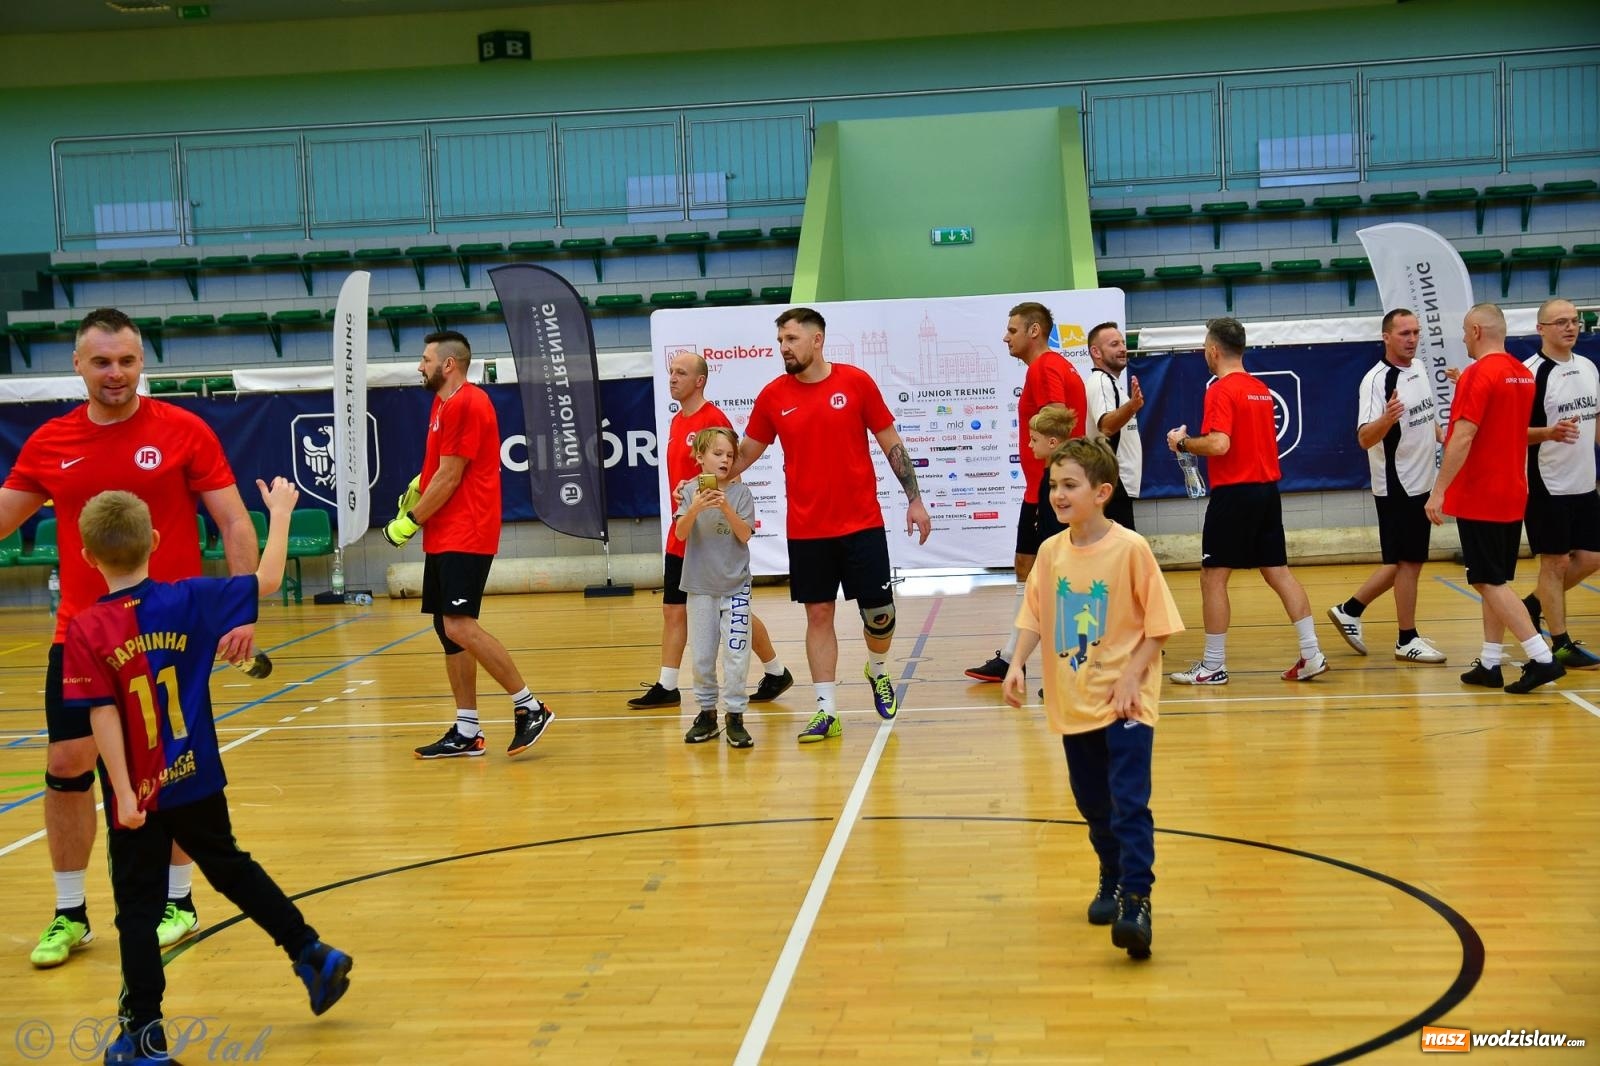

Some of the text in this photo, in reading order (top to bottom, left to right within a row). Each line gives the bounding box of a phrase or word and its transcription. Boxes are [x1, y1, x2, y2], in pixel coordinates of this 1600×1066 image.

[506, 40, 523, 56] B
[345, 312, 353, 396] TRENING
[703, 345, 774, 360] Racibórz
[708, 364, 723, 373] 217
[917, 389, 951, 398] JUNIOR
[954, 387, 996, 396] TRENING
[905, 435, 935, 443] Racibórz
[106, 631, 187, 671] RAPHINHA
[129, 665, 188, 750] 11
